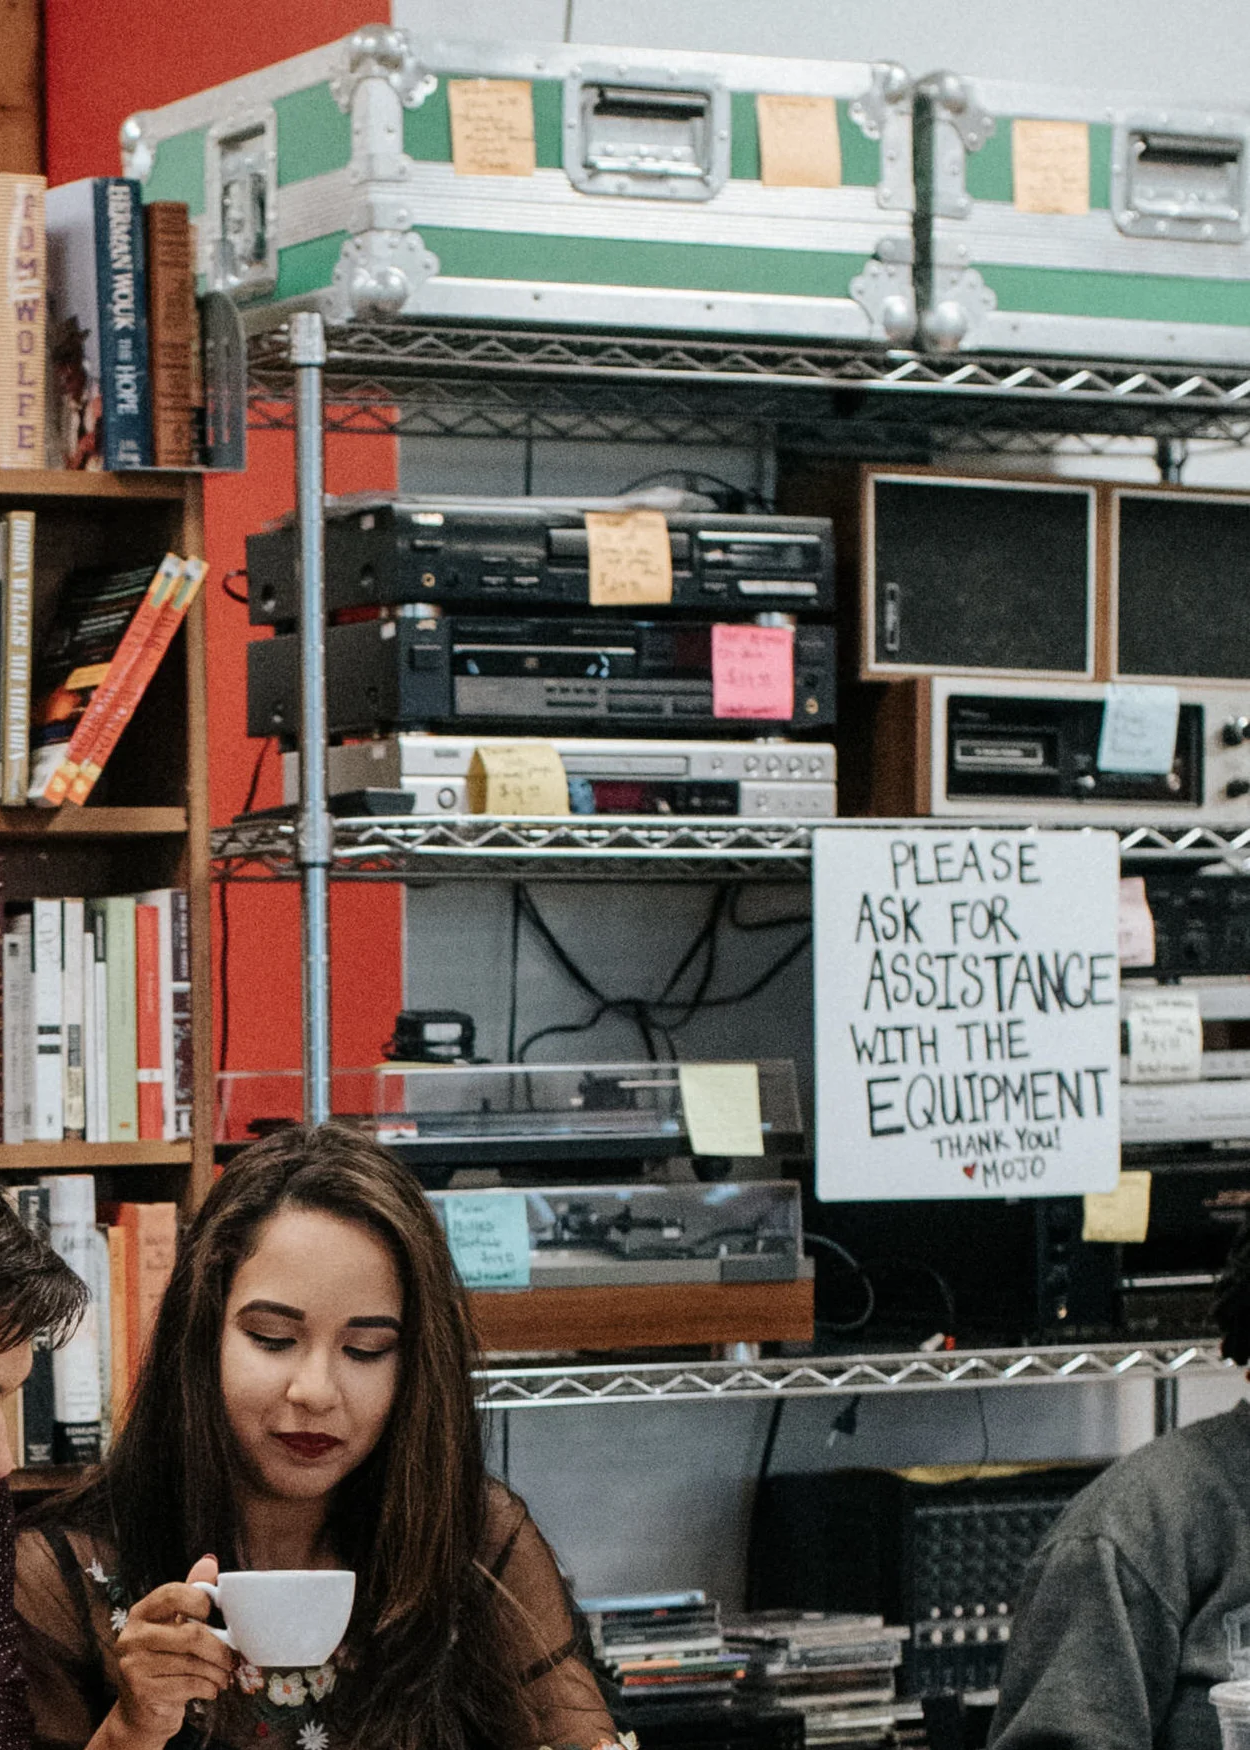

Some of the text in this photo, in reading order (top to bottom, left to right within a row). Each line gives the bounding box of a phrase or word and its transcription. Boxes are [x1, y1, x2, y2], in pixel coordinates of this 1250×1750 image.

[106, 185, 139, 415] HERMAN WOUK THE HOPE
[15, 301, 40, 451] WOLFE
[890, 839, 1042, 890] PLEASE
[854, 891, 1020, 944] ASK FOR
[863, 947, 1116, 1013] ASSISTANCE
[849, 1018, 1031, 1066] WITH THE
[866, 1066, 1109, 1138] EQUIPMENT
[930, 1129, 1010, 1159] THANK
[981, 1155, 1047, 1189] MOJO
